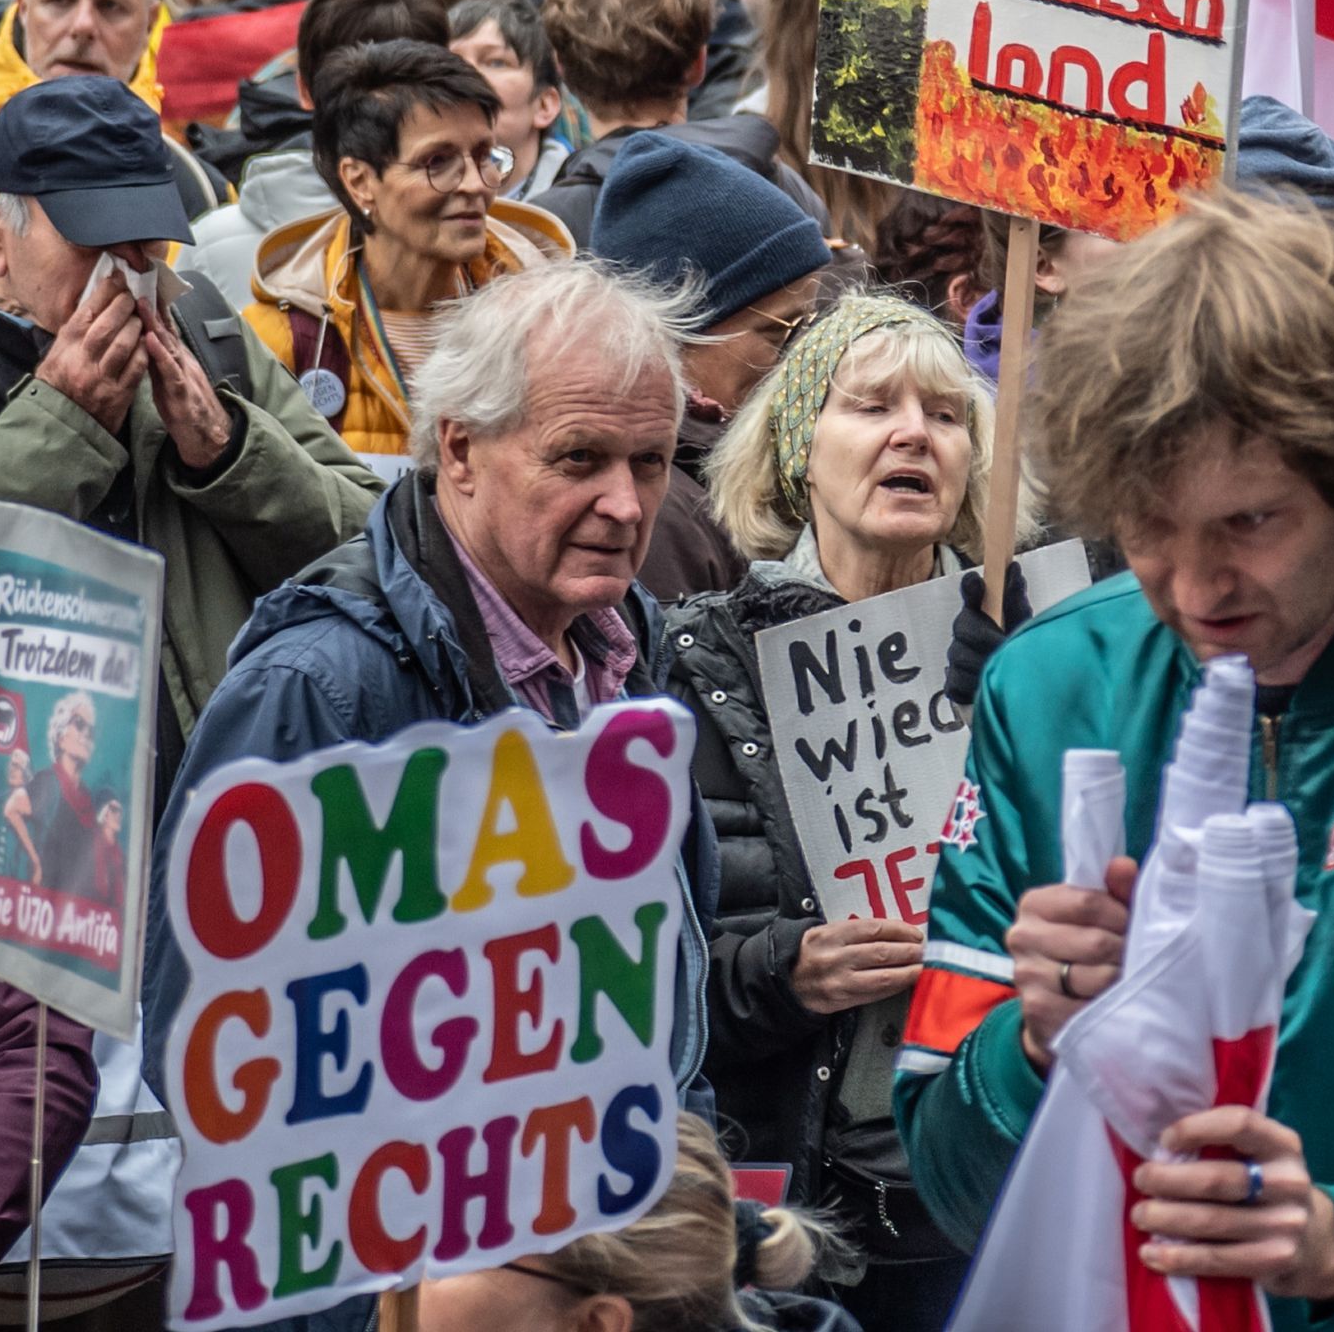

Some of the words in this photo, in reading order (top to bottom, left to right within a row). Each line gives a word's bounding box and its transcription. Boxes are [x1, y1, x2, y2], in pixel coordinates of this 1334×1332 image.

[1, 627, 97, 681] Trotzdem
[789, 619, 922, 716] Nie
[184, 708, 678, 961] OMAS
[826, 762, 914, 854] ist
[18, 885, 54, 940] Ü70
[56, 900, 118, 957] Antifa
[182, 901, 668, 1146] GEGEN
[183, 1084, 663, 1323] RECHTS
